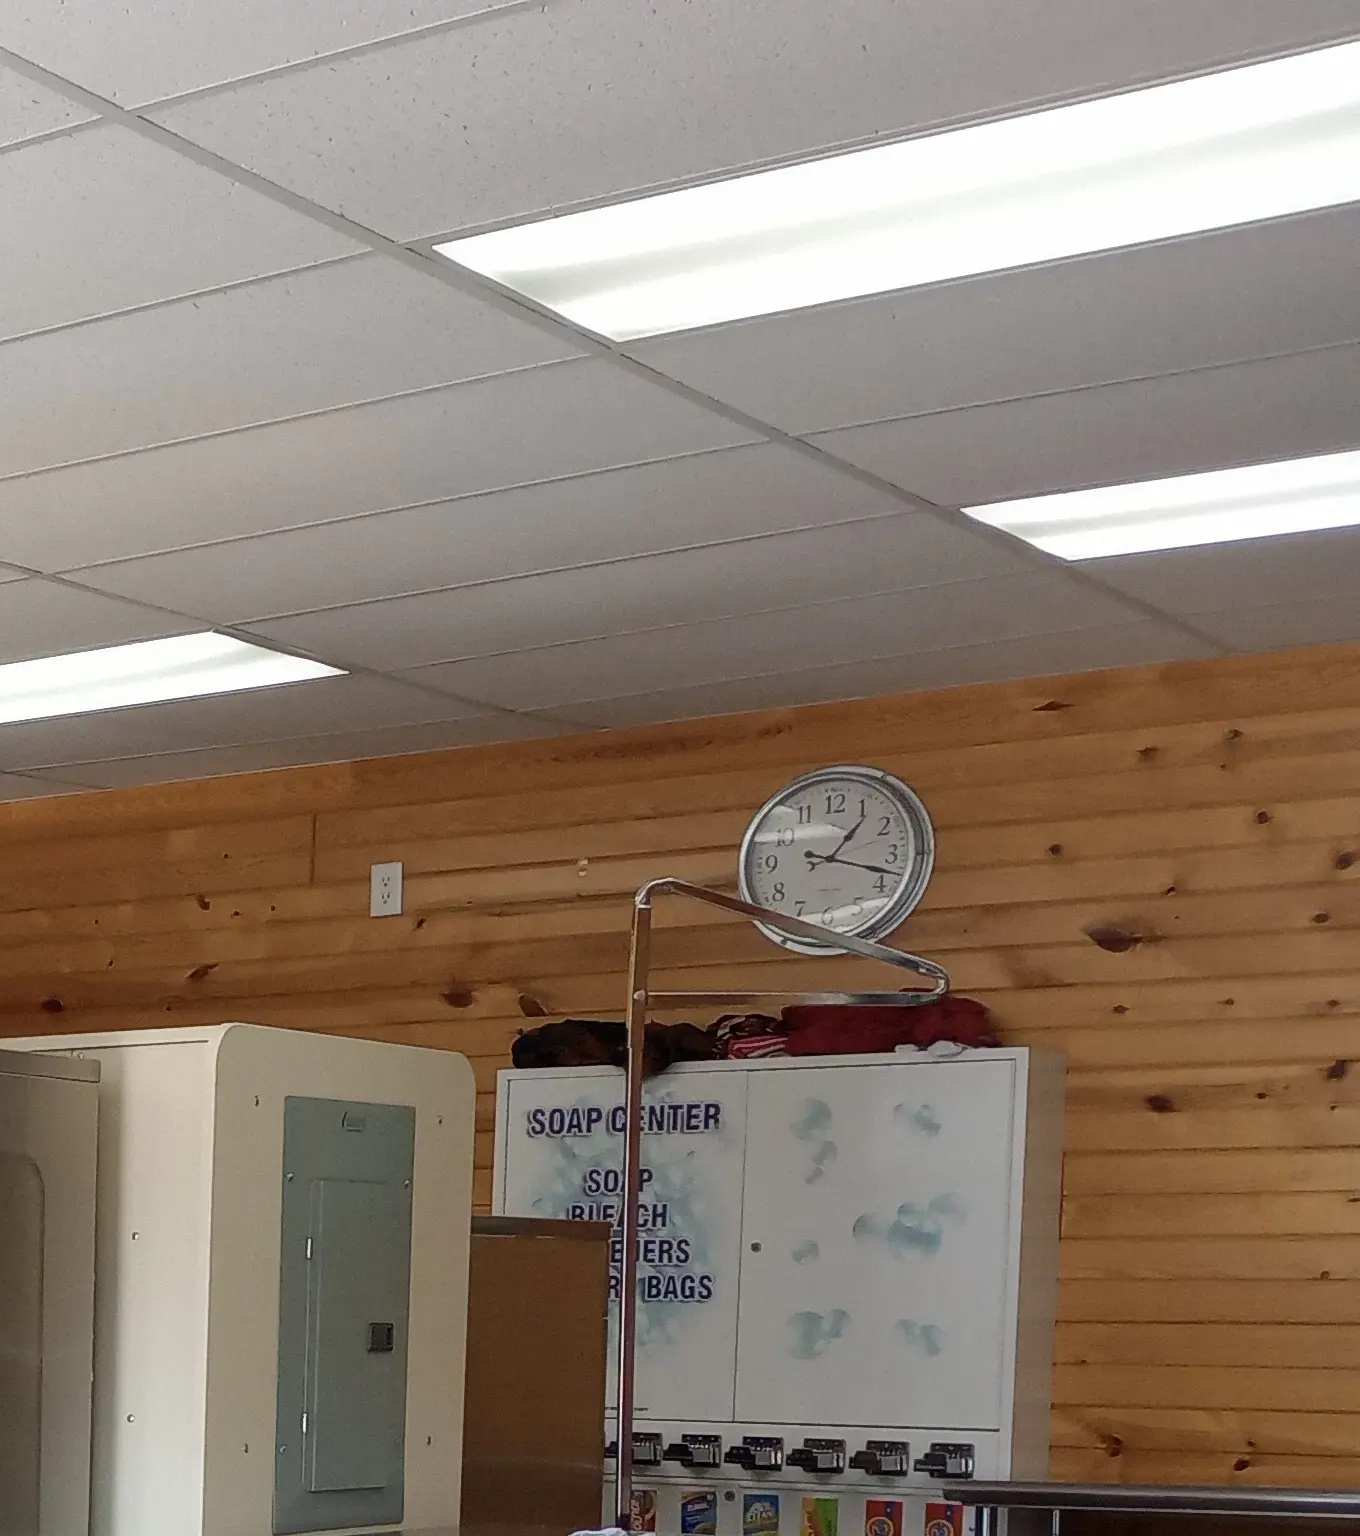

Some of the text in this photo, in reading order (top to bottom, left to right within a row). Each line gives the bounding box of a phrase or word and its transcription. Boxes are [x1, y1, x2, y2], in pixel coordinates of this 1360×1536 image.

[797, 804, 812, 824] 11
[825, 794, 846, 815] 12
[859, 799, 866, 818] 1
[877, 816, 891, 837] 2
[774, 828, 795, 848] 10
[885, 844, 898, 864] 3
[765, 855, 778, 874] 9
[772, 882, 785, 901] 8
[873, 875, 887, 893] 4
[794, 901, 806, 917] 7
[530, 1107, 603, 1135] SOAP
[646, 1275, 713, 1300] BAGS
